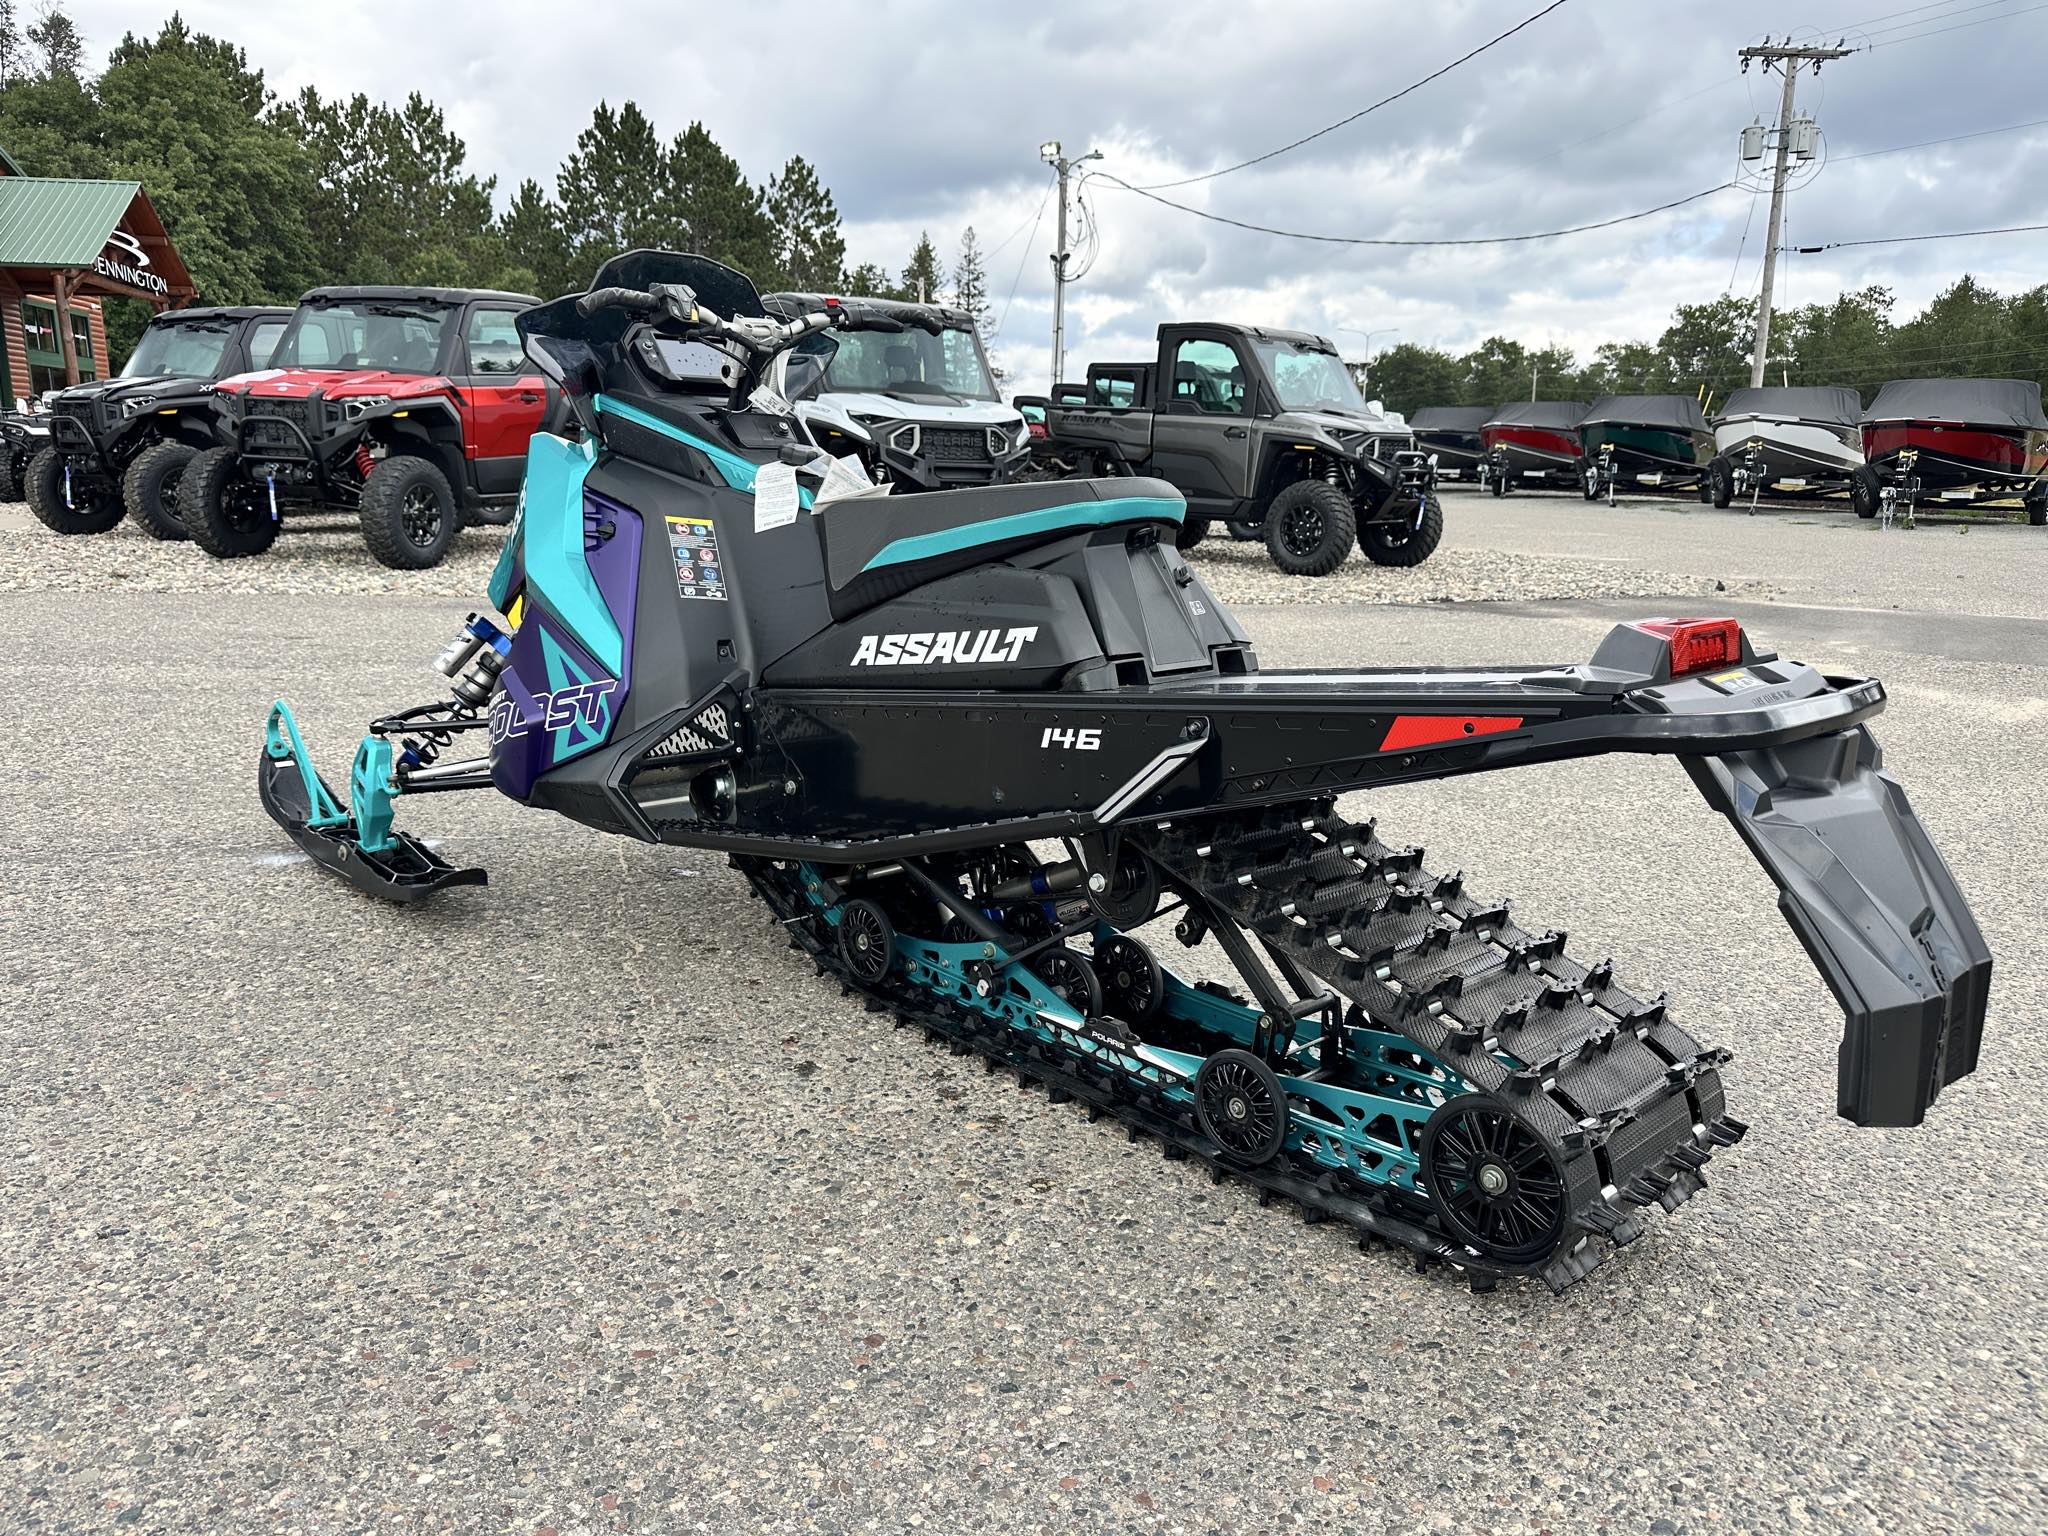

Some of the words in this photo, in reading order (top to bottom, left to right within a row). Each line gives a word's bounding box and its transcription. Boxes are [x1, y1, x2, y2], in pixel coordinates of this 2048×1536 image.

[94, 256, 168, 293] ENNINGTON
[1061, 414, 1112, 425] RANGER
[922, 435, 983, 447] POLARIS
[850, 626, 1039, 667] ASSAULT
[1041, 728, 1102, 750] 146
[1091, 1030, 1126, 1050] POLARIS
